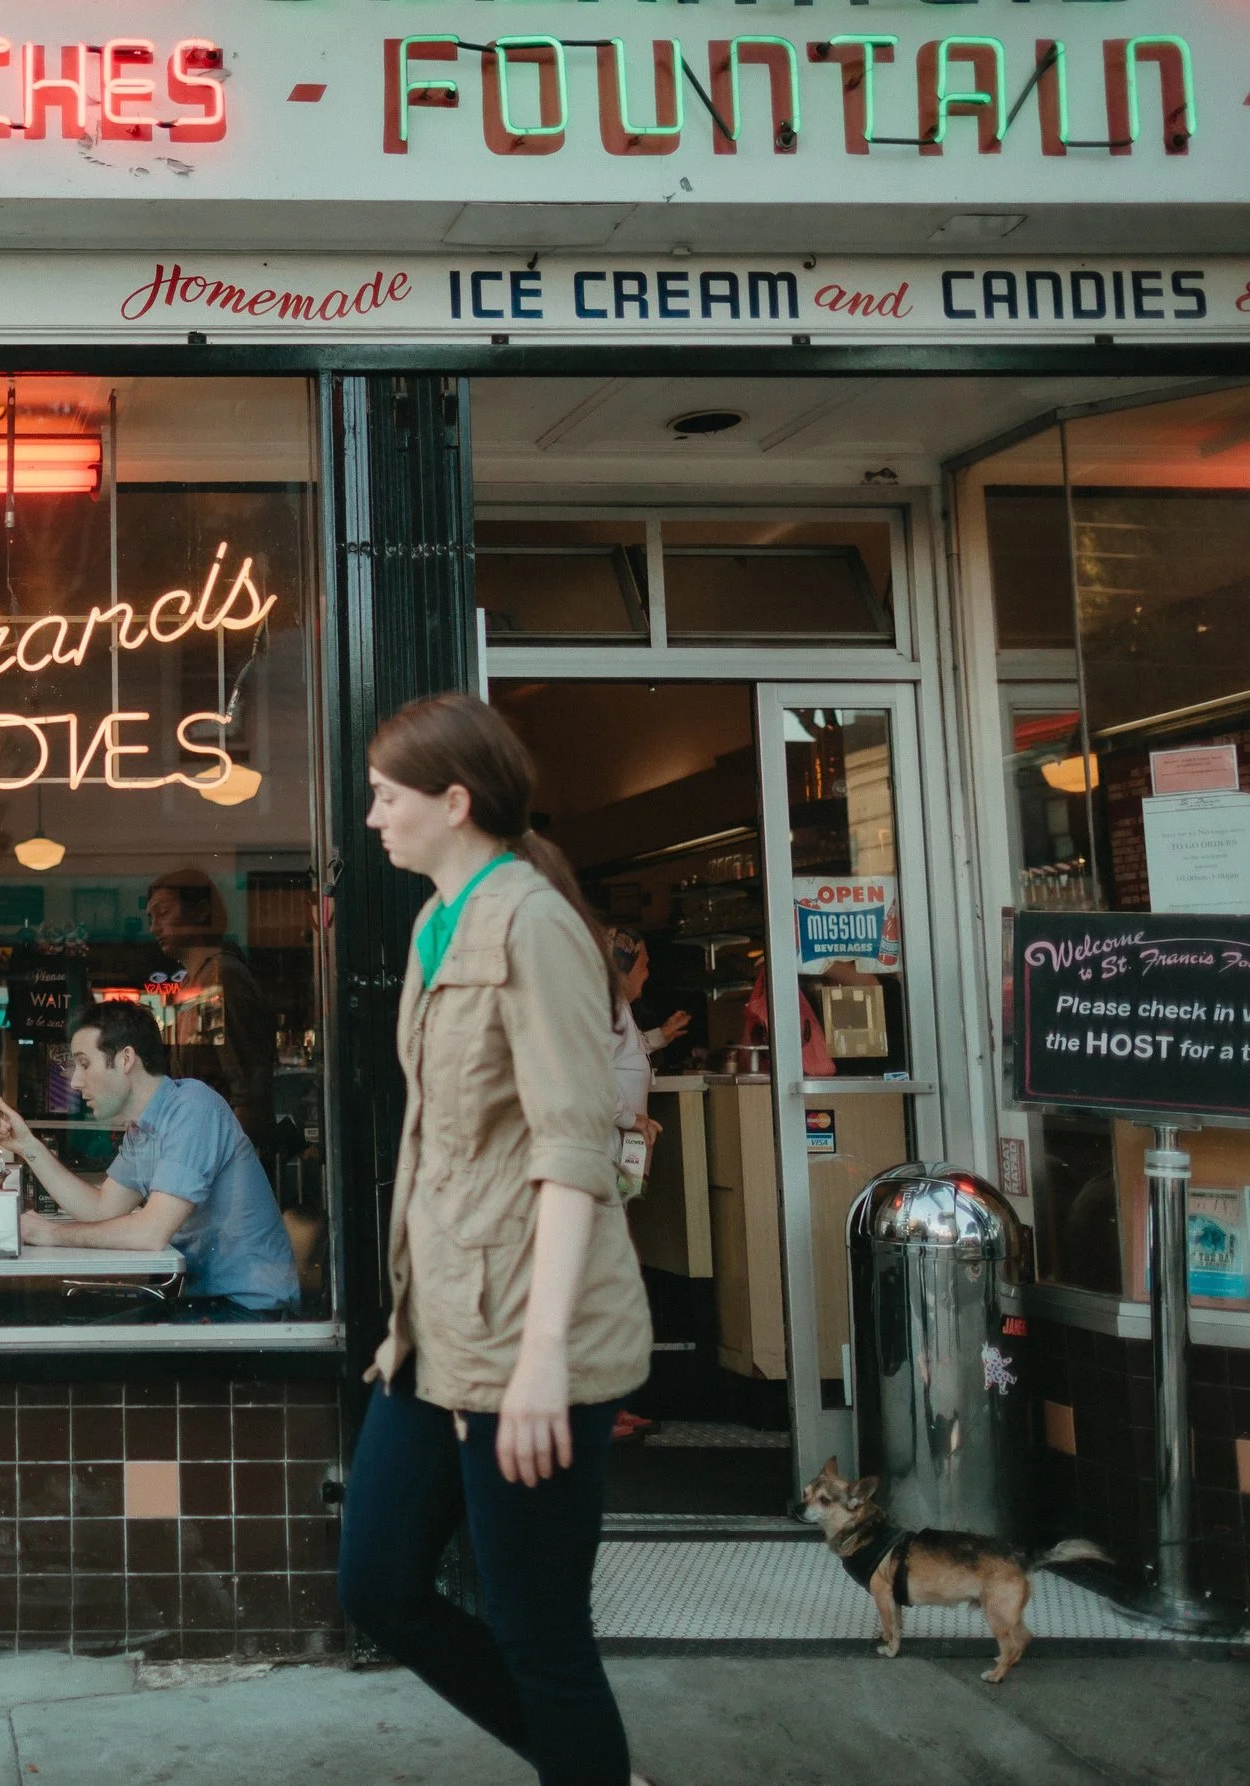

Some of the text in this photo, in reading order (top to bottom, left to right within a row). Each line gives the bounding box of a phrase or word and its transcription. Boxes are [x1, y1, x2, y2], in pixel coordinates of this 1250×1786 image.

[383, 34, 1197, 157] FOUNTAIN
[121, 264, 412, 320] Homemade
[450, 270, 544, 319] ICE
[573, 270, 800, 319] CREAM
[814, 281, 913, 320] and
[942, 270, 1207, 319] CANDIES
[817, 886, 884, 904] OPEN
[807, 914, 878, 941] MISSION
[814, 943, 873, 953] BEVERAGES
[1026, 931, 1146, 972] Welcome
[1079, 966, 1093, 981] to
[1101, 955, 1132, 979] St.
[1139, 948, 1215, 977] Francis
[30, 992, 72, 1011] WAIT
[1056, 995, 1131, 1017] Please
[1138, 1000, 1207, 1021] check
[1213, 1003, 1235, 1022] in
[1045, 1033, 1080, 1051] the
[1086, 1032, 1174, 1059] HOST
[1179, 1039, 1214, 1059] for
[1219, 1046, 1233, 1061] a
[1001, 1140, 1011, 1193] ZAGAT
